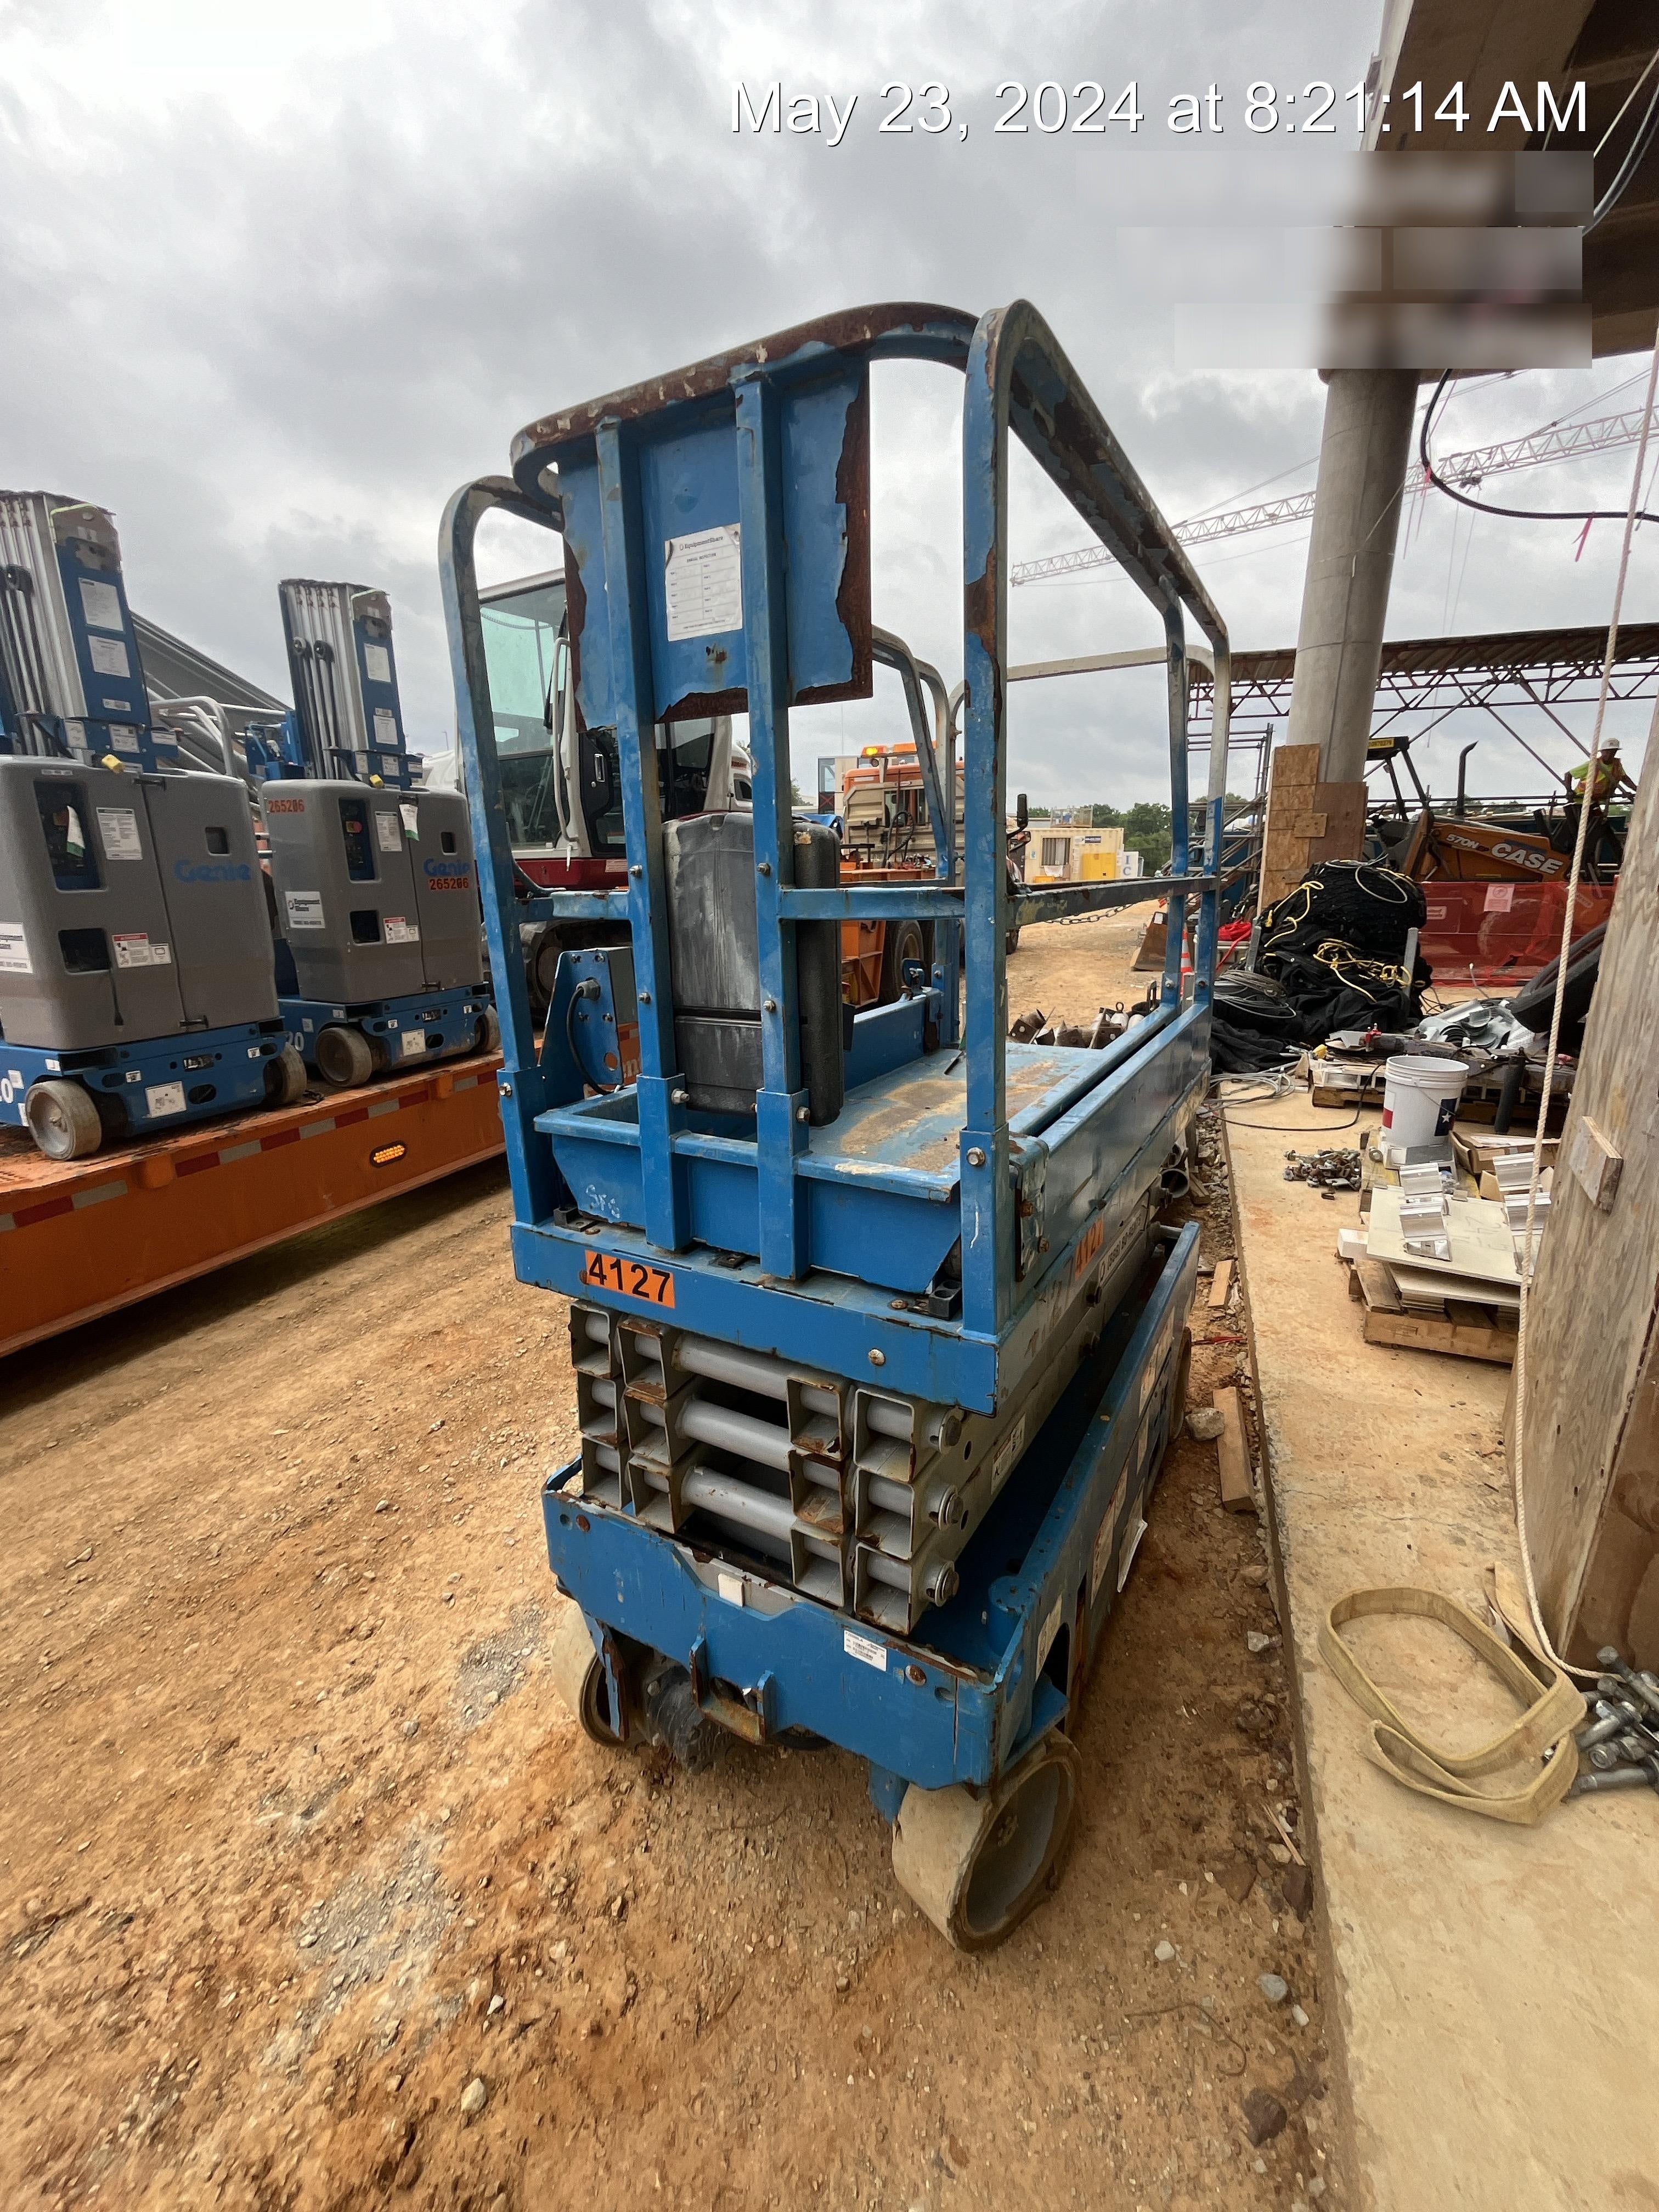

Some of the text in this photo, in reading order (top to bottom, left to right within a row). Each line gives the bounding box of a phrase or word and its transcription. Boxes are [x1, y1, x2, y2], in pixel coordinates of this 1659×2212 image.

[685, 536, 724, 549] EquipmentShare
[1446, 833, 1480, 849] 570N
[422, 858, 471, 877] Genie
[1491, 843, 1564, 874] CASE
[174, 859, 251, 883] Genie
[589, 1253, 671, 1303] 4127
